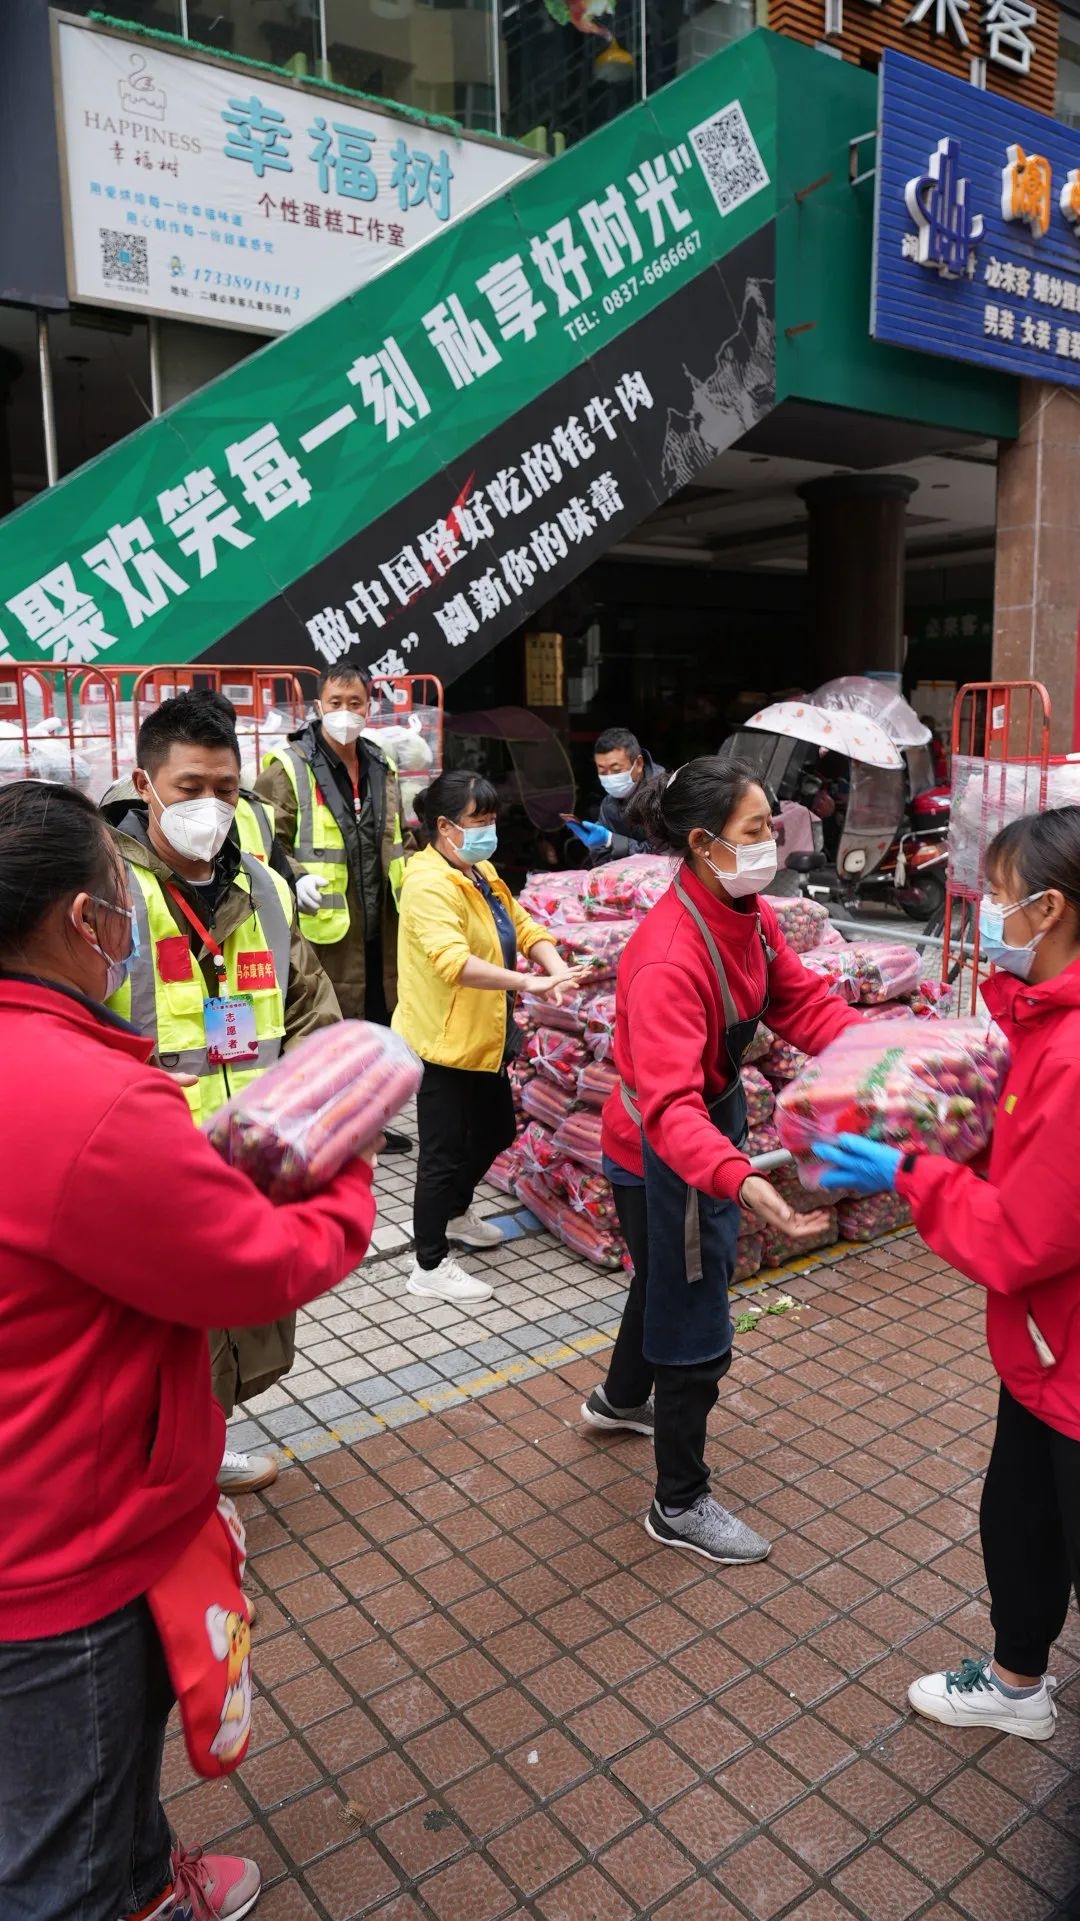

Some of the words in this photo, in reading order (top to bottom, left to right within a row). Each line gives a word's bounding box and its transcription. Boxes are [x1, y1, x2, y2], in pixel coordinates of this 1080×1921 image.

[84, 110, 202, 154] HAPPINESS
[221, 96, 454, 221] 幸福树
[258, 192, 406, 247] 个性蛋糕工作室
[193, 268, 302, 300] 17338918113
[564, 310, 600, 341] TEL:
[602, 230, 702, 315] 0837-6666667
[983, 304, 1015, 340] 男装
[1021, 316, 1051, 349] 女装
[0, 336, 432, 663] 聚欢笑每一刻
[225, 1012, 238, 1049] 志愿者
